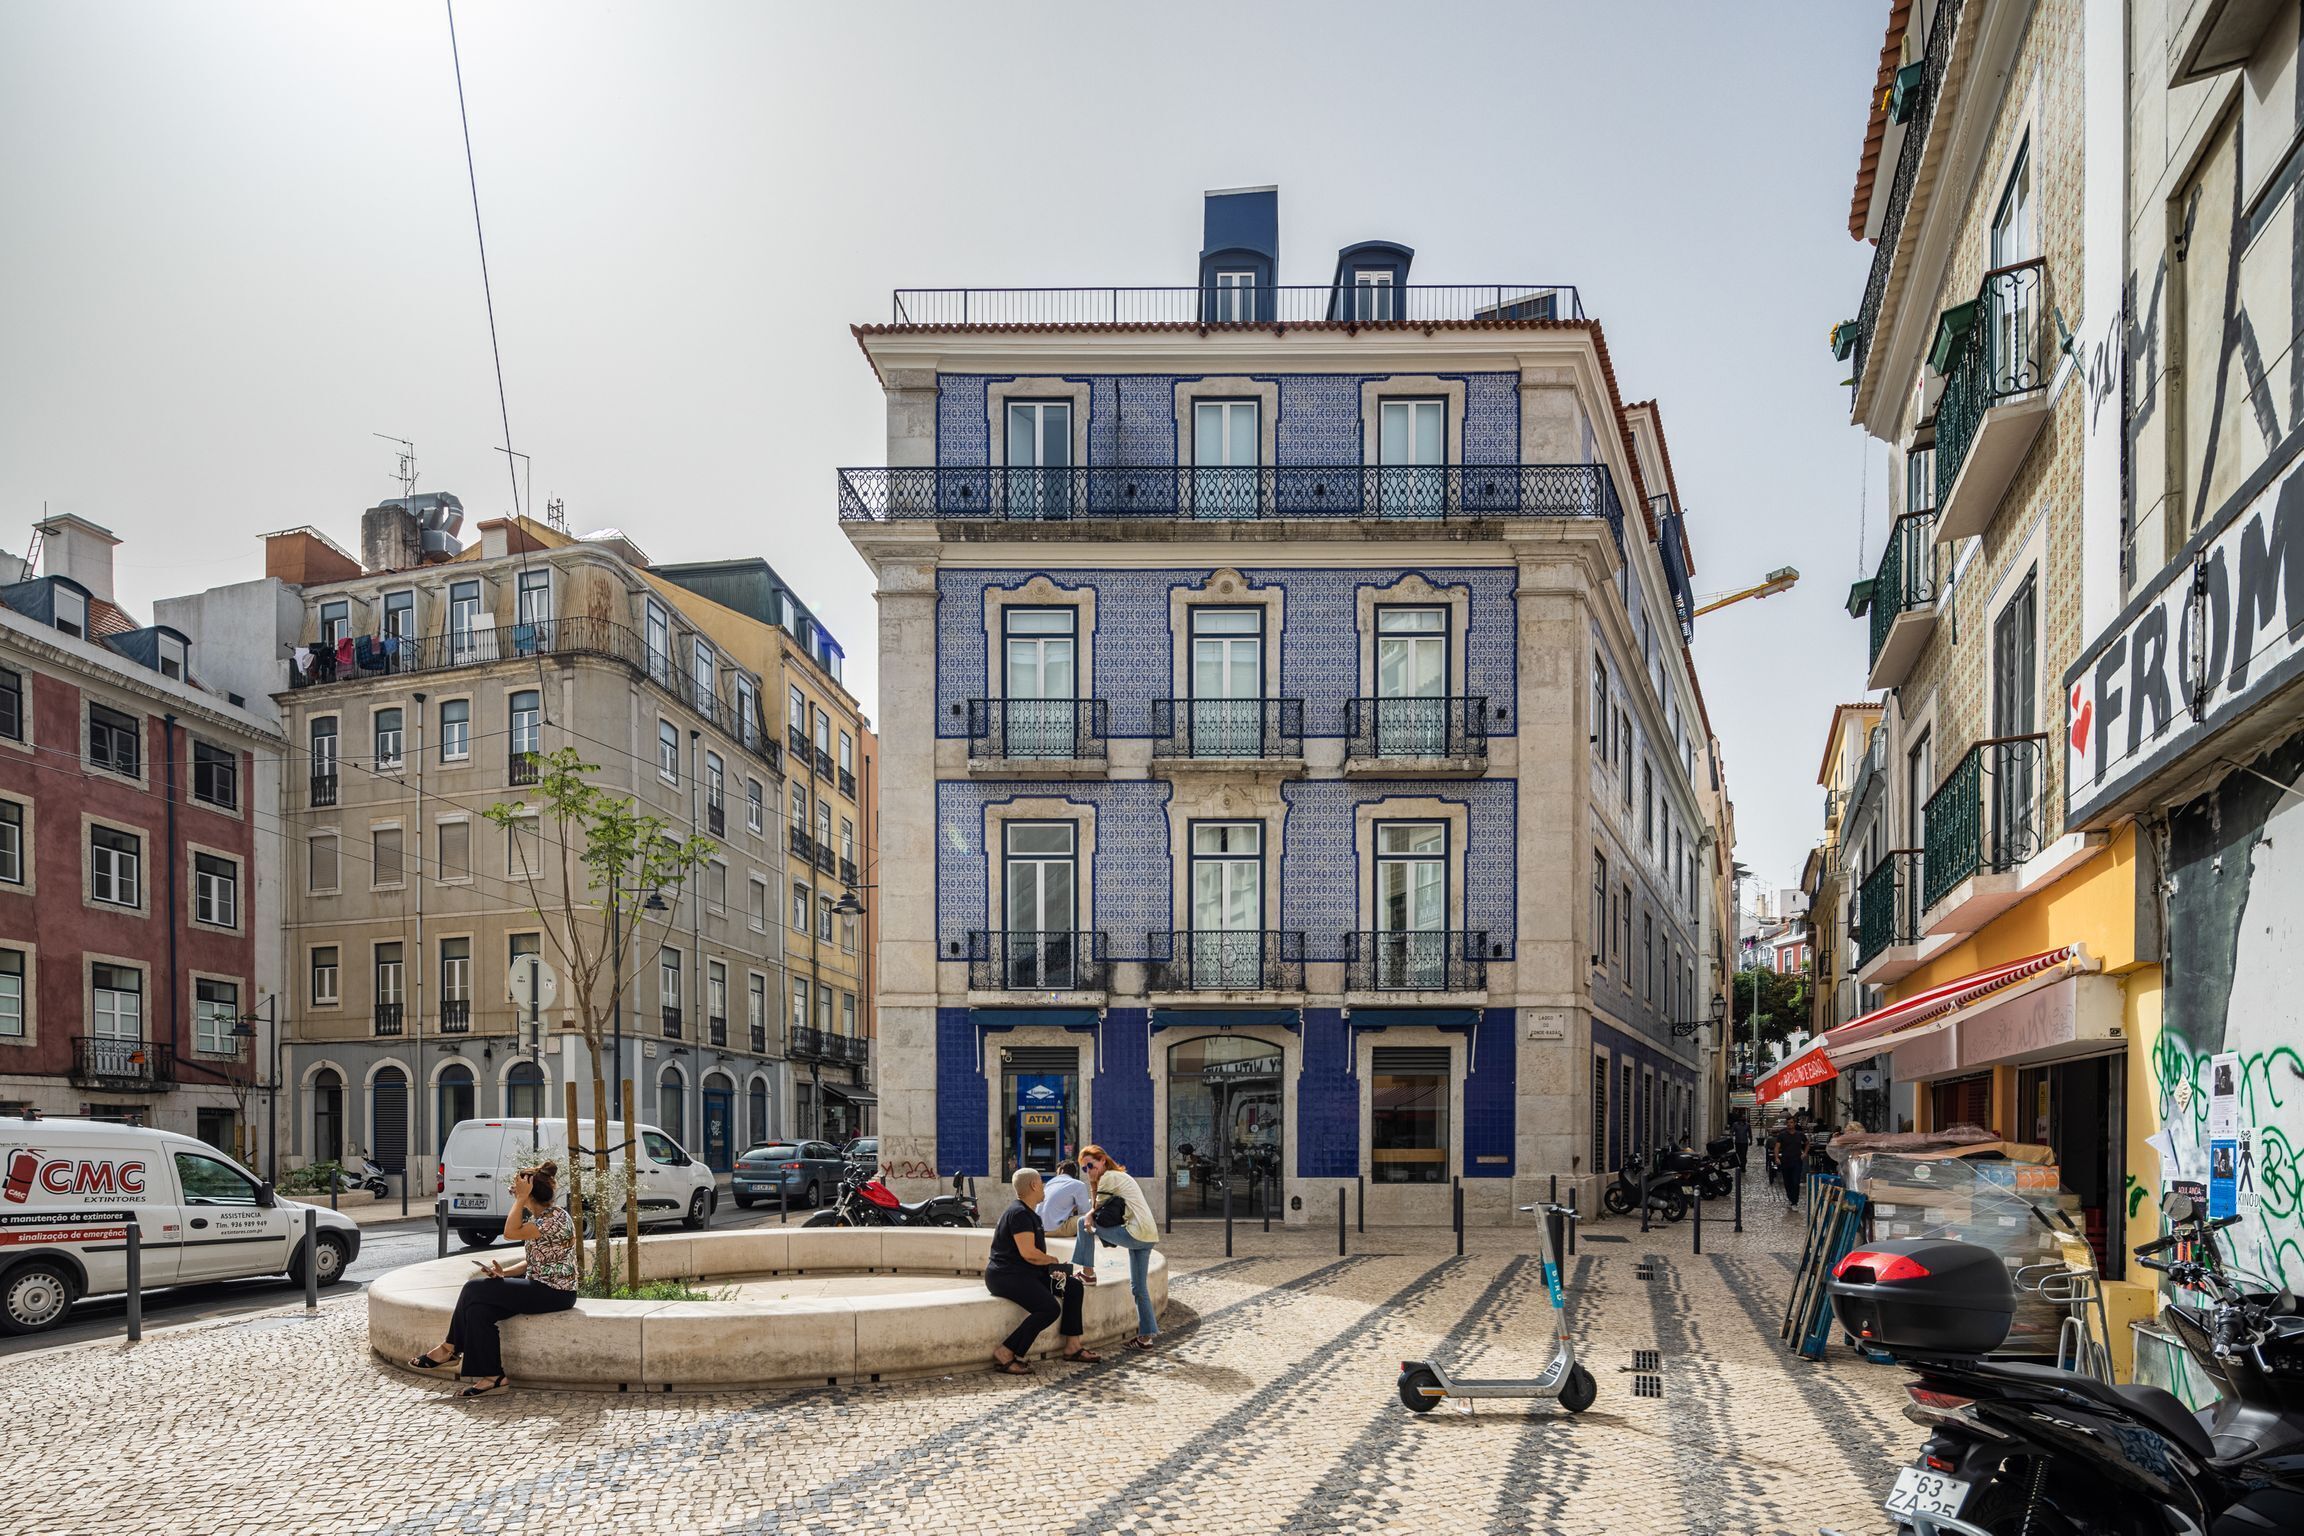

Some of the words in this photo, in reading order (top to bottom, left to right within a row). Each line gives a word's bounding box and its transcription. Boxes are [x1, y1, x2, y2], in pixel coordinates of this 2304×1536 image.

[2094, 458, 2304, 788] FROM
[1028, 1115, 1053, 1123] ATM
[39, 1159, 146, 1194] CMC
[7, 1188, 27, 1200] CMC
[10, 1213, 68, 1224] manutenção
[70, 1211, 81, 1221] de
[83, 1212, 124, 1221] extintores
[220, 1211, 262, 1219] ASSISTÊNCIA
[256, 1219, 268, 1227] 949
[18, 1230, 69, 1242] sinalização
[70, 1229, 81, 1239] de
[1551, 1270, 1562, 1301] BIRD
[2028, 1411, 2099, 1436] PCX
[1916, 1475, 1944, 1498] 63
